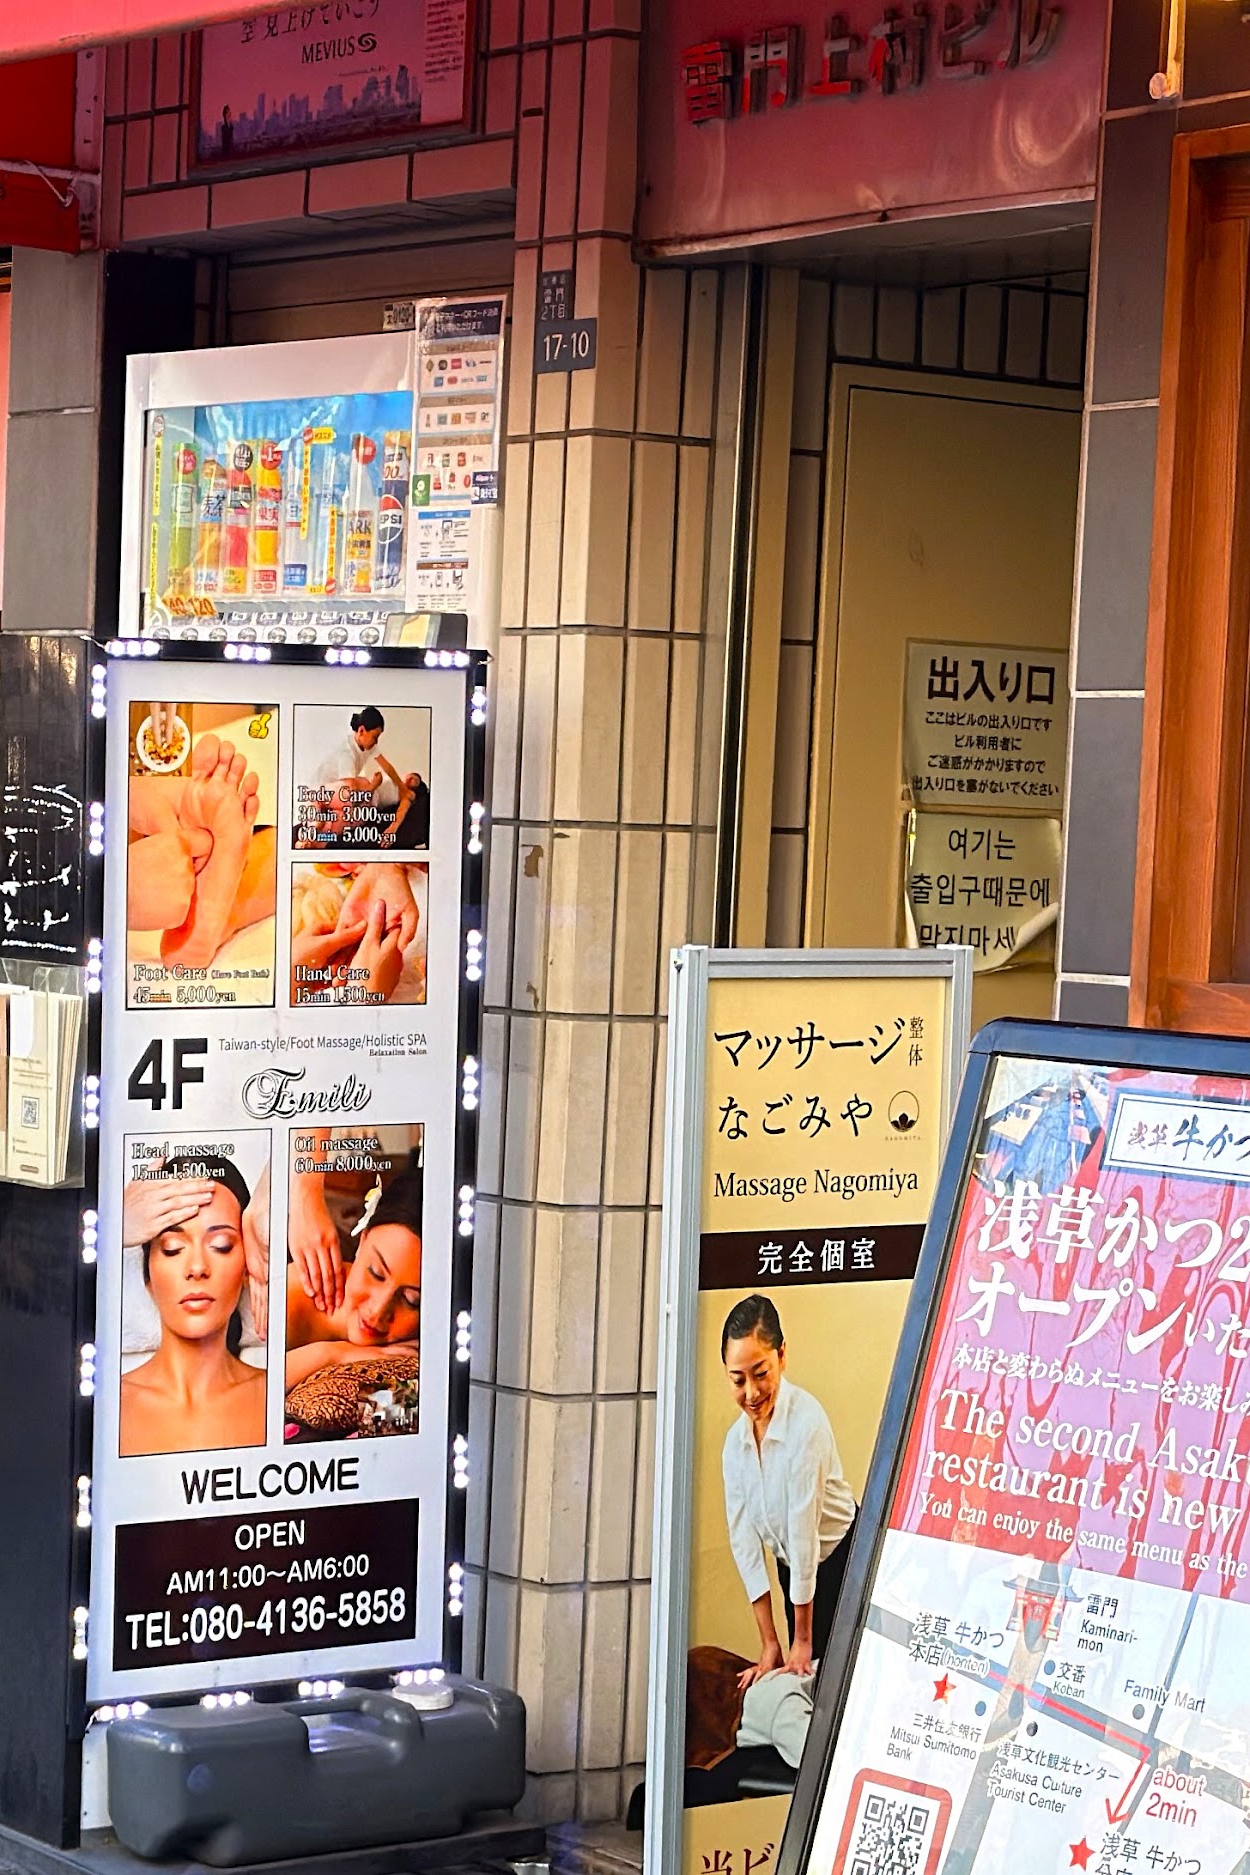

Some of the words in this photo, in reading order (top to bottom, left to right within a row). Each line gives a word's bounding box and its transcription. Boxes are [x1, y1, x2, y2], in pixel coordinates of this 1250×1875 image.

[302, 35, 356, 63] MEVIUS
[543, 331, 590, 361] 17-10
[379, 514, 403, 525] EPSI
[927, 655, 1055, 705] 出入り口
[925, 711, 1053, 731] ここはビルの出入り口です
[954, 734, 1023, 752] ビル利用者に
[927, 754, 1046, 774] ご迷惑がかかりますので
[297, 785, 335, 806] Body
[339, 785, 373, 803] Care
[297, 805, 337, 822] 30min
[342, 805, 397, 824] 3,000yen
[297, 826, 338, 843] 60min
[342, 826, 397, 845] 5,000yen
[949, 828, 1016, 860] 여기는
[910, 873, 1051, 908] 출입구때문에
[133, 964, 169, 982] Foot
[172, 964, 208, 981] Care
[295, 964, 332, 982] Hand
[337, 964, 370, 981] Care
[133, 986, 172, 1004] 45min
[176, 985, 237, 1004] 5,000yen
[295, 986, 331, 1004] 15min
[219, 1036, 314, 1053] Taiwan-style/Foot
[317, 1033, 404, 1052] Massage/Holistic
[407, 1033, 427, 1046] SPA
[408, 1047, 427, 1056] Salon
[714, 1017, 905, 1070] マッサージ
[908, 1016, 924, 1067] 整体
[127, 1037, 208, 1111] 4F
[241, 1066, 372, 1120] Emili
[718, 1093, 873, 1140] なごみや
[131, 1142, 170, 1159] Head
[174, 1142, 235, 1158] massage
[294, 1135, 316, 1152] Oil
[321, 1136, 379, 1152] massage
[131, 1164, 170, 1182] 15min
[294, 1157, 334, 1174] 60min
[713, 1172, 808, 1203] Massage
[814, 1167, 919, 1201] Nagomiya
[757, 1237, 876, 1276] 完全個室
[939, 1388, 1005, 1439] The
[1015, 1414, 1141, 1464] second
[1148, 1427, 1250, 1486] Asak
[181, 1457, 360, 1505] WELCOME
[922, 1449, 1107, 1512] restaurant
[1116, 1472, 1149, 1520] is
[1158, 1489, 1240, 1537] new
[234, 1519, 306, 1551] OPEN
[919, 1491, 953, 1520] You
[957, 1503, 988, 1527] can
[993, 1510, 1041, 1540] enjoy
[1045, 1517, 1073, 1544] the
[1078, 1529, 1125, 1554] same
[1131, 1538, 1184, 1567] menu
[1188, 1550, 1210, 1571] as
[1216, 1552, 1248, 1580] the
[125, 1586, 406, 1651] TEL:080-4136-5858
[1086, 1593, 1119, 1619] 雷門
[914, 1611, 951, 1638] 浅草
[954, 1621, 1005, 1649] 牛かつ
[1080, 1619, 1138, 1645] Kaminari-
[1077, 1637, 1104, 1653] mon
[1056, 1661, 1087, 1685] 交番
[1052, 1680, 1085, 1699] Koban
[1124, 1679, 1170, 1707] Family
[1174, 1690, 1206, 1714] Mart
[886, 1743, 913, 1761] Bank
[890, 1725, 921, 1746] Mitsui
[923, 1734, 977, 1761] Sumitomo
[991, 1763, 1038, 1787] Asakusa
[998, 1741, 1120, 1782] 浅草文化観光センター
[1153, 1768, 1207, 1797] about
[988, 1780, 1025, 1804] Tourist
[1028, 1792, 1067, 1815] Center
[1146, 1792, 1198, 1828] 2min
[1100, 1831, 1141, 1863] 浅草
[1146, 1844, 1202, 1875] 牛かつ
